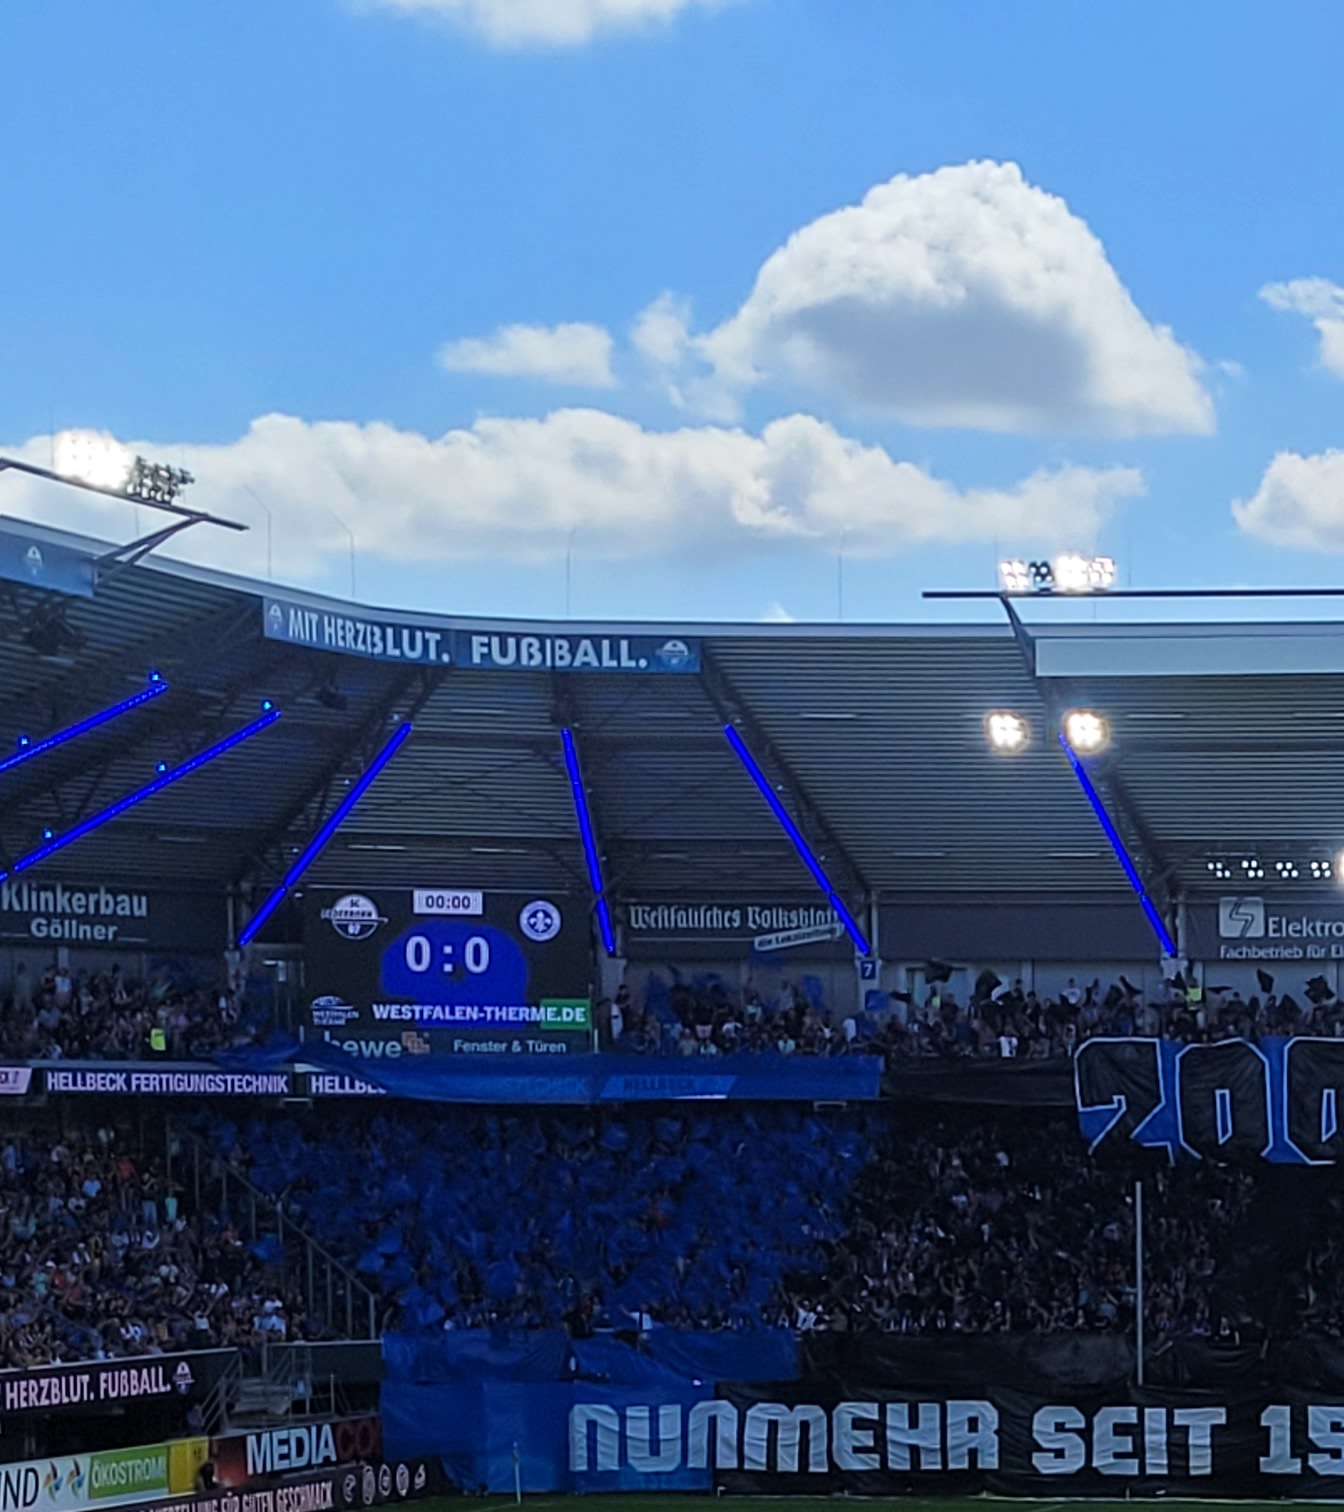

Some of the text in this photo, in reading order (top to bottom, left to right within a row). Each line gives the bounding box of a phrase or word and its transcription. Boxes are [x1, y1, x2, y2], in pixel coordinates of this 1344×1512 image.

[287, 607, 319, 643] MIT
[324, 613, 450, 664] HERZBLUT.
[0, 882, 147, 917] Klinkerbau
[425, 895, 471, 909] 00:00
[31, 917, 118, 941] Göllner
[1307, 944, 1326, 958] für
[863, 962, 873, 977] 7
[373, 1003, 587, 1022] WESTFALEN-THERME.DE
[453, 1039, 507, 1053] Fenster
[526, 1039, 566, 1053] Türen
[47, 1071, 289, 1093] HELLBECK FERTIGUNGSTECHNIK
[5, 1375, 95, 1411] HERZBLUT.
[568, 1400, 999, 1473] NUNMEHR
[1031, 1405, 1227, 1475] SEIT
[0, 1466, 39, 1512] ND
